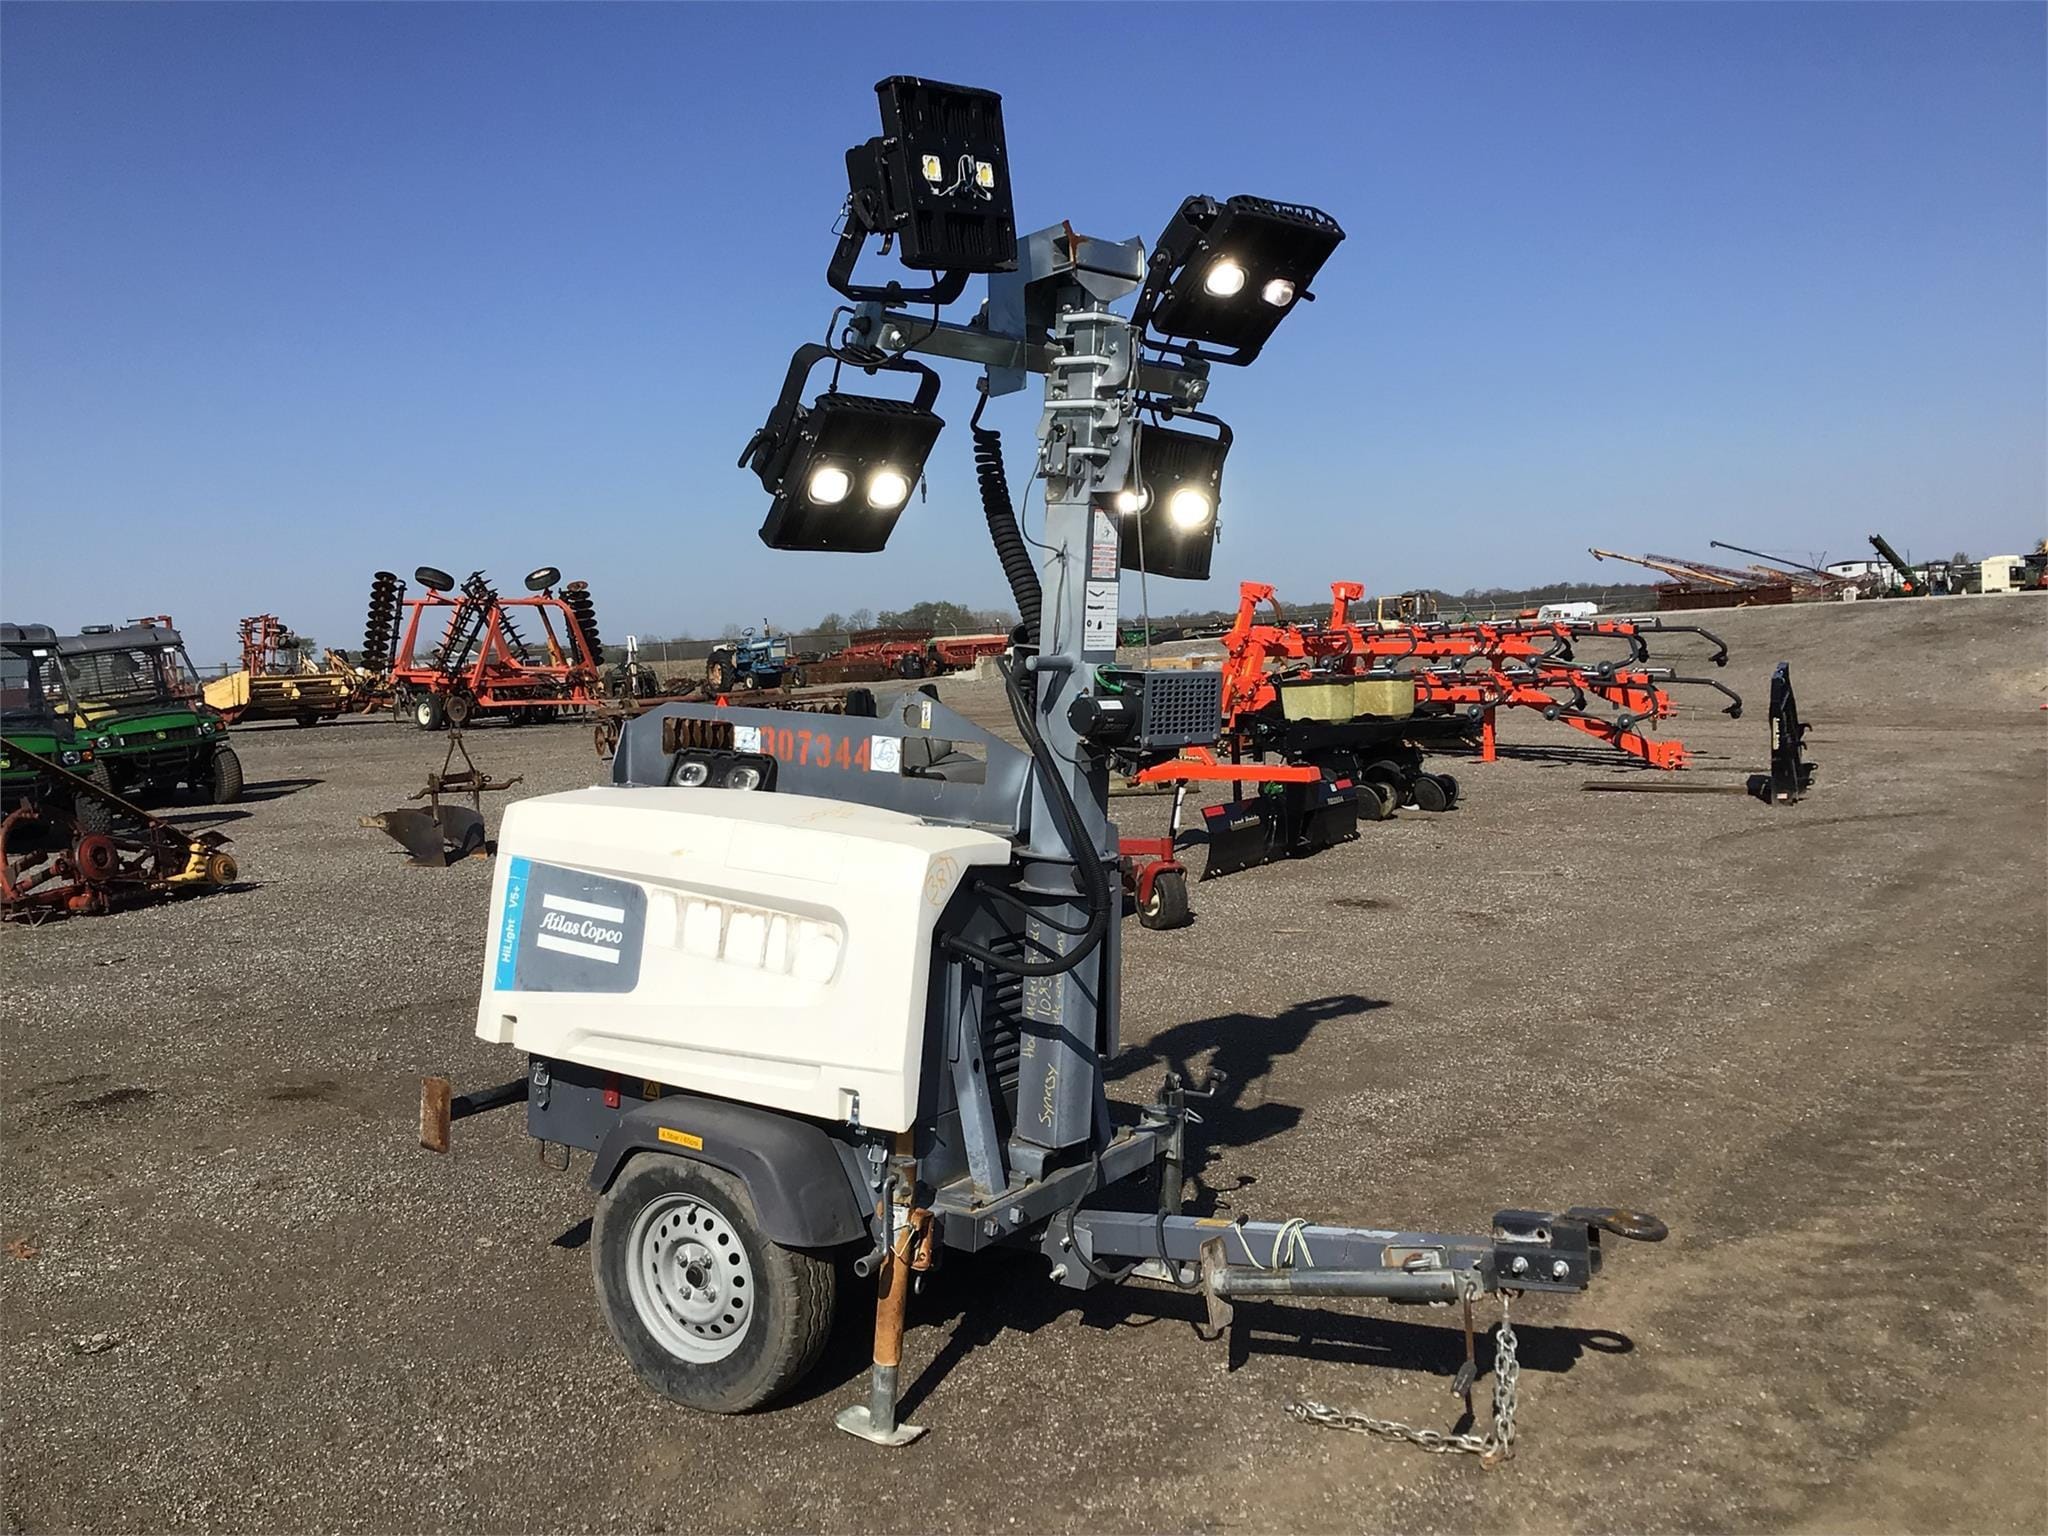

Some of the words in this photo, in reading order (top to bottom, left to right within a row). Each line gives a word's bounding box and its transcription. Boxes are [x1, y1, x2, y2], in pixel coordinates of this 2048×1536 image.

[508, 884, 522, 909] V5+
[501, 917, 517, 964] HiLight
[540, 911, 581, 935] Atlas
[580, 922, 623, 945] Copco
